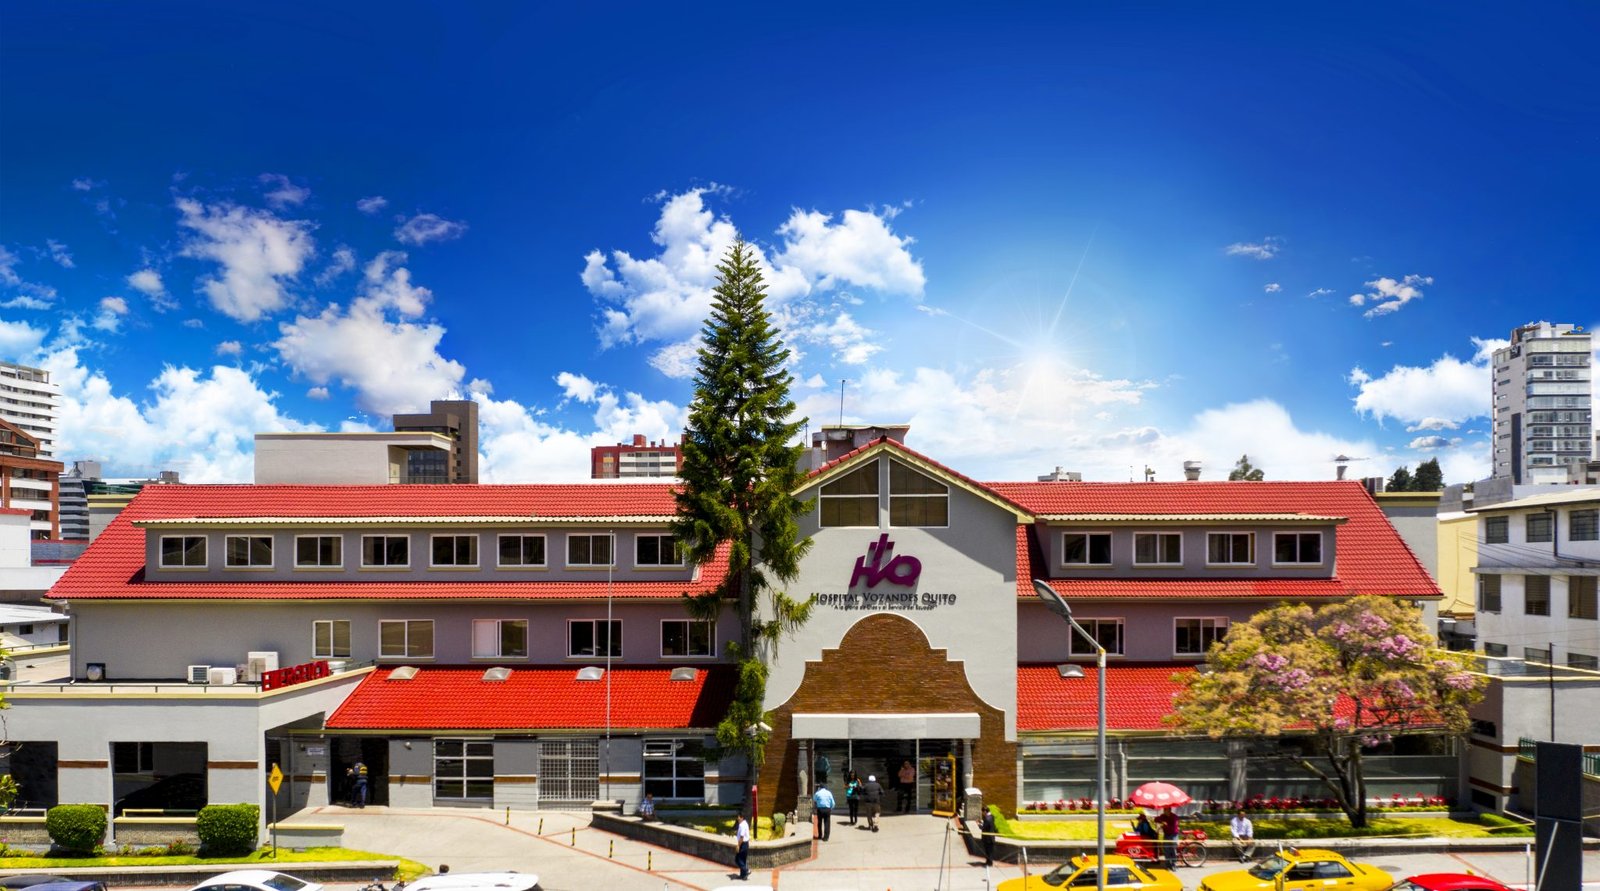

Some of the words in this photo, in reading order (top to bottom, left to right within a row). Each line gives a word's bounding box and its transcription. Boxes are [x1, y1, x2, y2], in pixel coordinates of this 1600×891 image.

[811, 592, 859, 603] HOSPITAL
[863, 592, 918, 603] VOZANDES
[922, 592, 957, 604] QUITO
